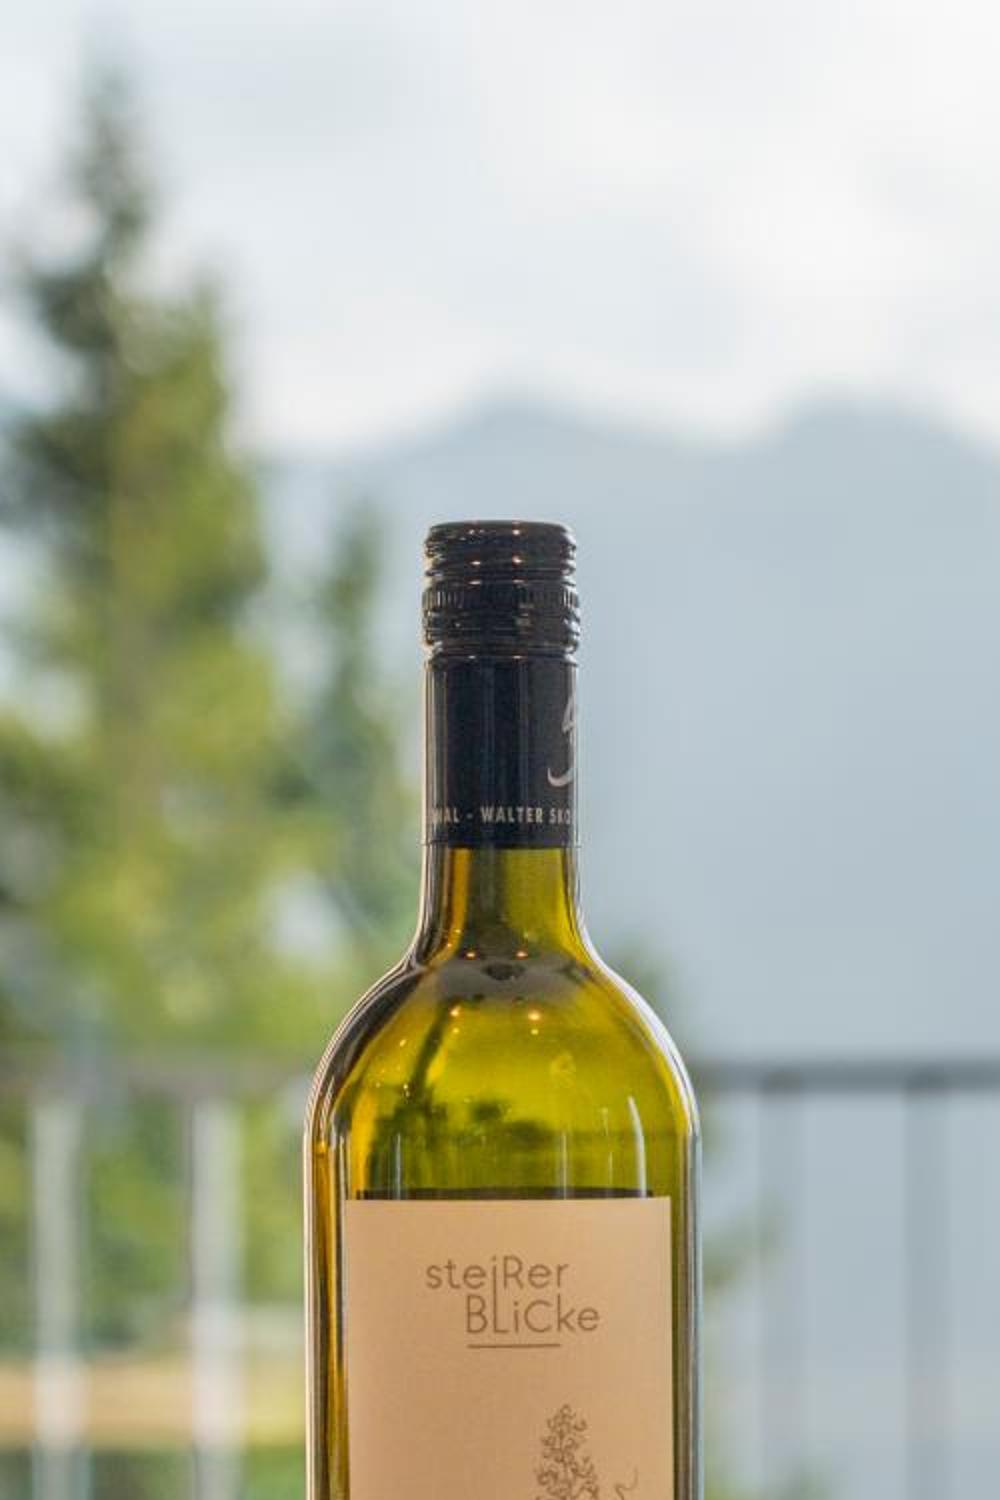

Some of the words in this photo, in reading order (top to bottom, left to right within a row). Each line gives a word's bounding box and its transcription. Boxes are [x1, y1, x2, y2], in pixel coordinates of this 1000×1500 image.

[480, 807, 543, 824] WALTER
[425, 1254, 569, 1290] steiRer
[465, 1293, 600, 1334] BLiCke
